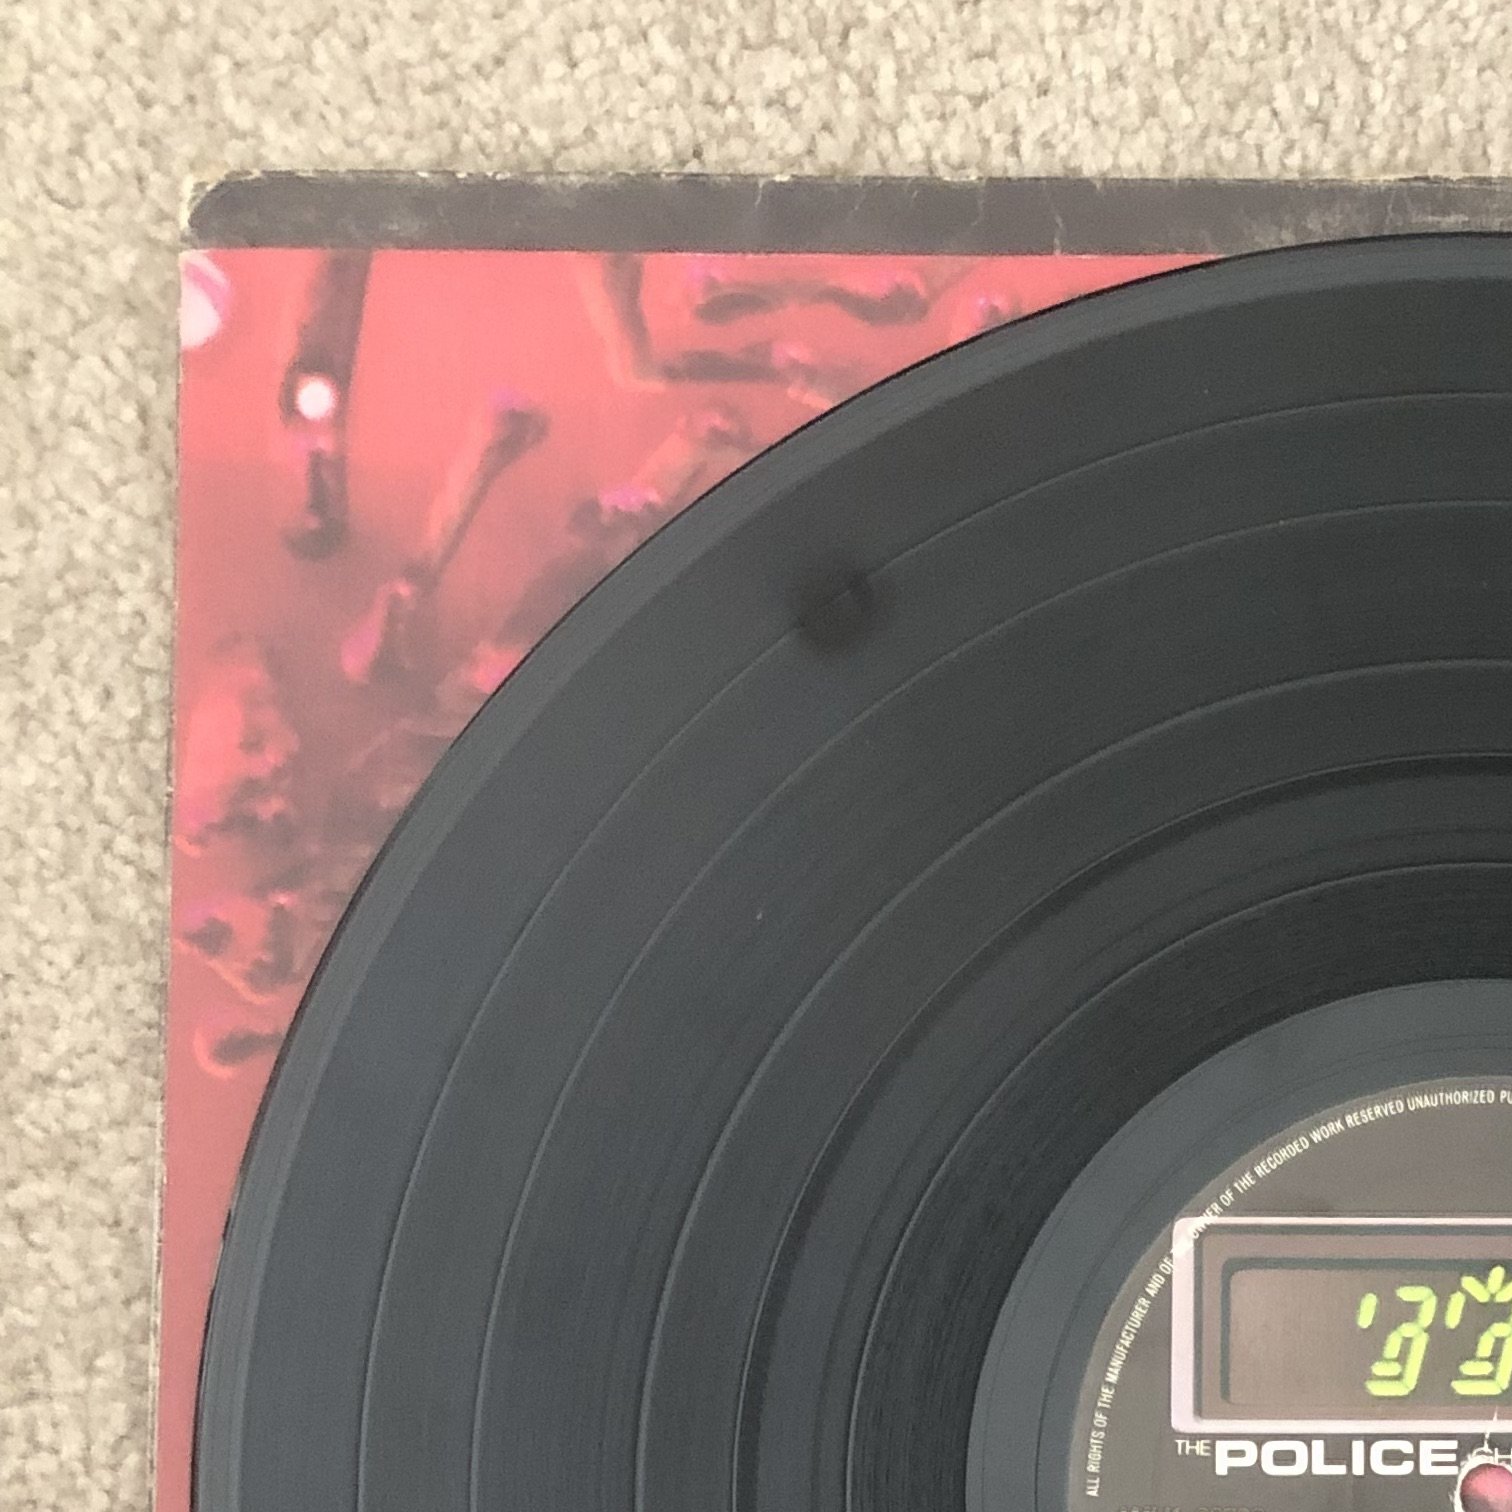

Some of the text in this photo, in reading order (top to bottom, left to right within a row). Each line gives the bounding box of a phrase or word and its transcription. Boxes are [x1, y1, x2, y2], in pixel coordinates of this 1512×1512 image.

[1407, 1090, 1495, 1111] UNAUTHORIZED
[1346, 1098, 1405, 1128] RESERVED
[1309, 1118, 1345, 1143] WORK
[1253, 1136, 1310, 1178] RECORDED
[1233, 1171, 1257, 1194] THE
[1219, 1188, 1235, 1207] OF
[1144, 1275, 1165, 1297] AND
[1105, 1298, 1152, 1384] MANUFACTURER
[1097, 1385, 1116, 1409] THE
[1093, 1413, 1108, 1428] OF
[1087, 1431, 1105, 1473] RIGHTS
[1175, 1439, 1211, 1456] THE
[1215, 1439, 1458, 1476] POLICE
[1086, 1477, 1099, 1497] ALL
